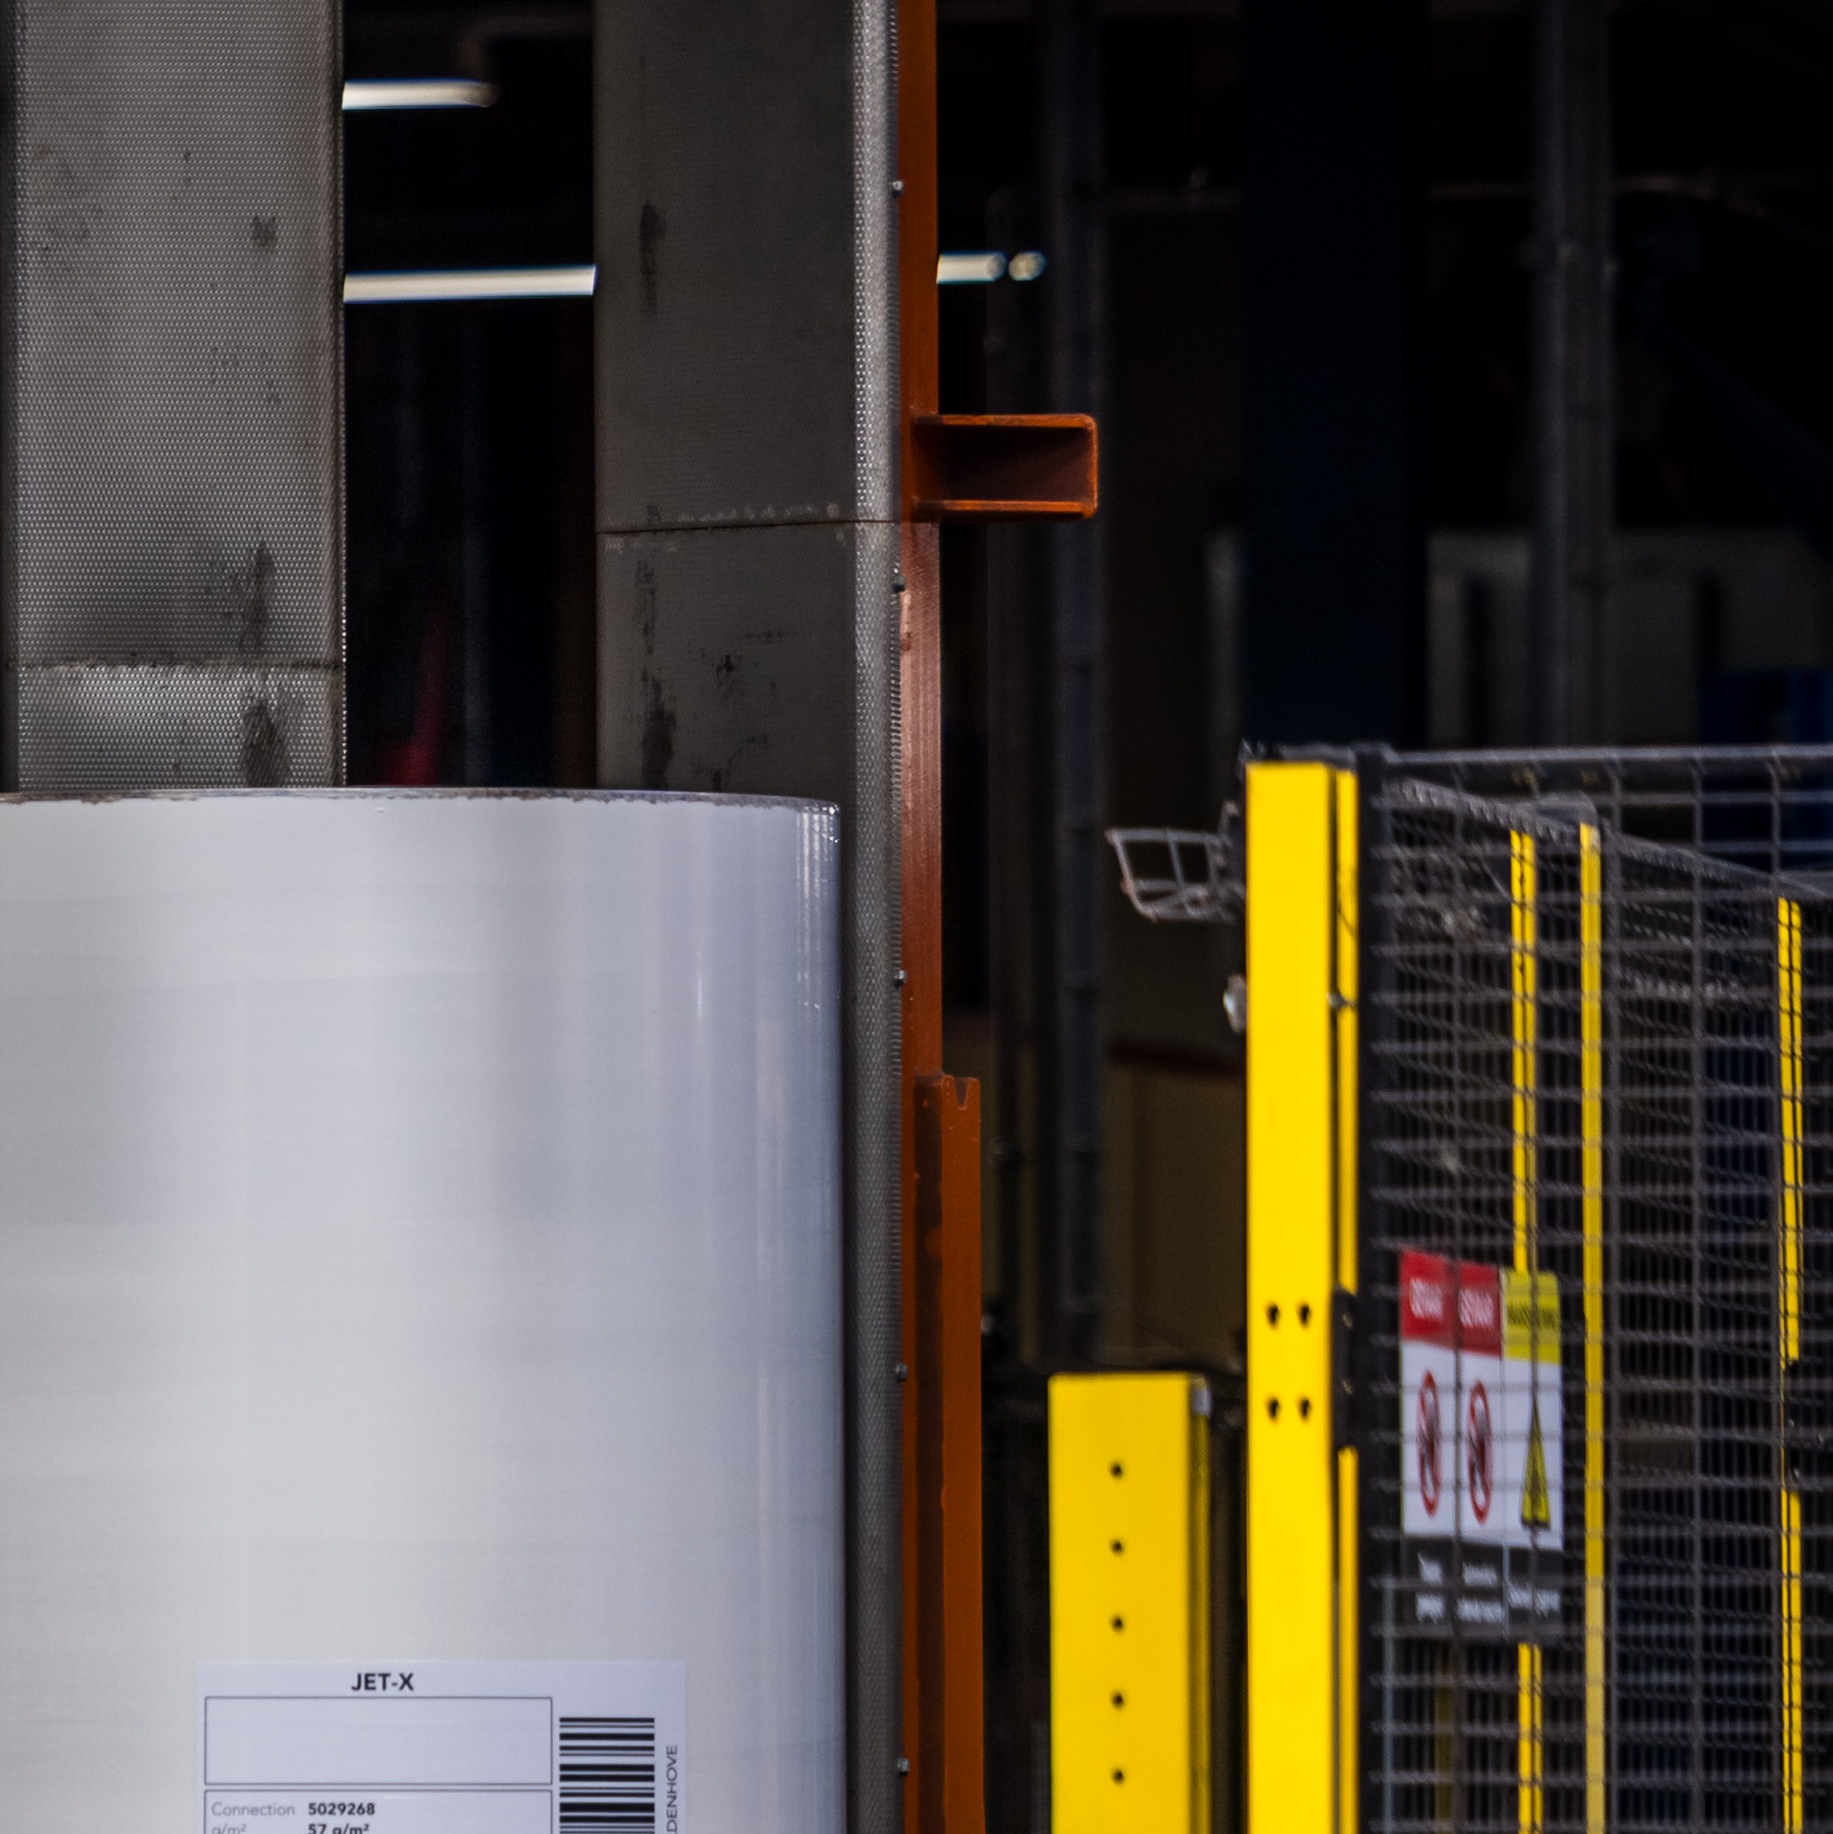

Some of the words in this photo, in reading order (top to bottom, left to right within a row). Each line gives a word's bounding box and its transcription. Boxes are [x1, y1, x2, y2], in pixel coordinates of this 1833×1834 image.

[351, 1672, 414, 1692] JET-X
[210, 1801, 296, 1817] Connection
[307, 1802, 376, 1817] 5029268
